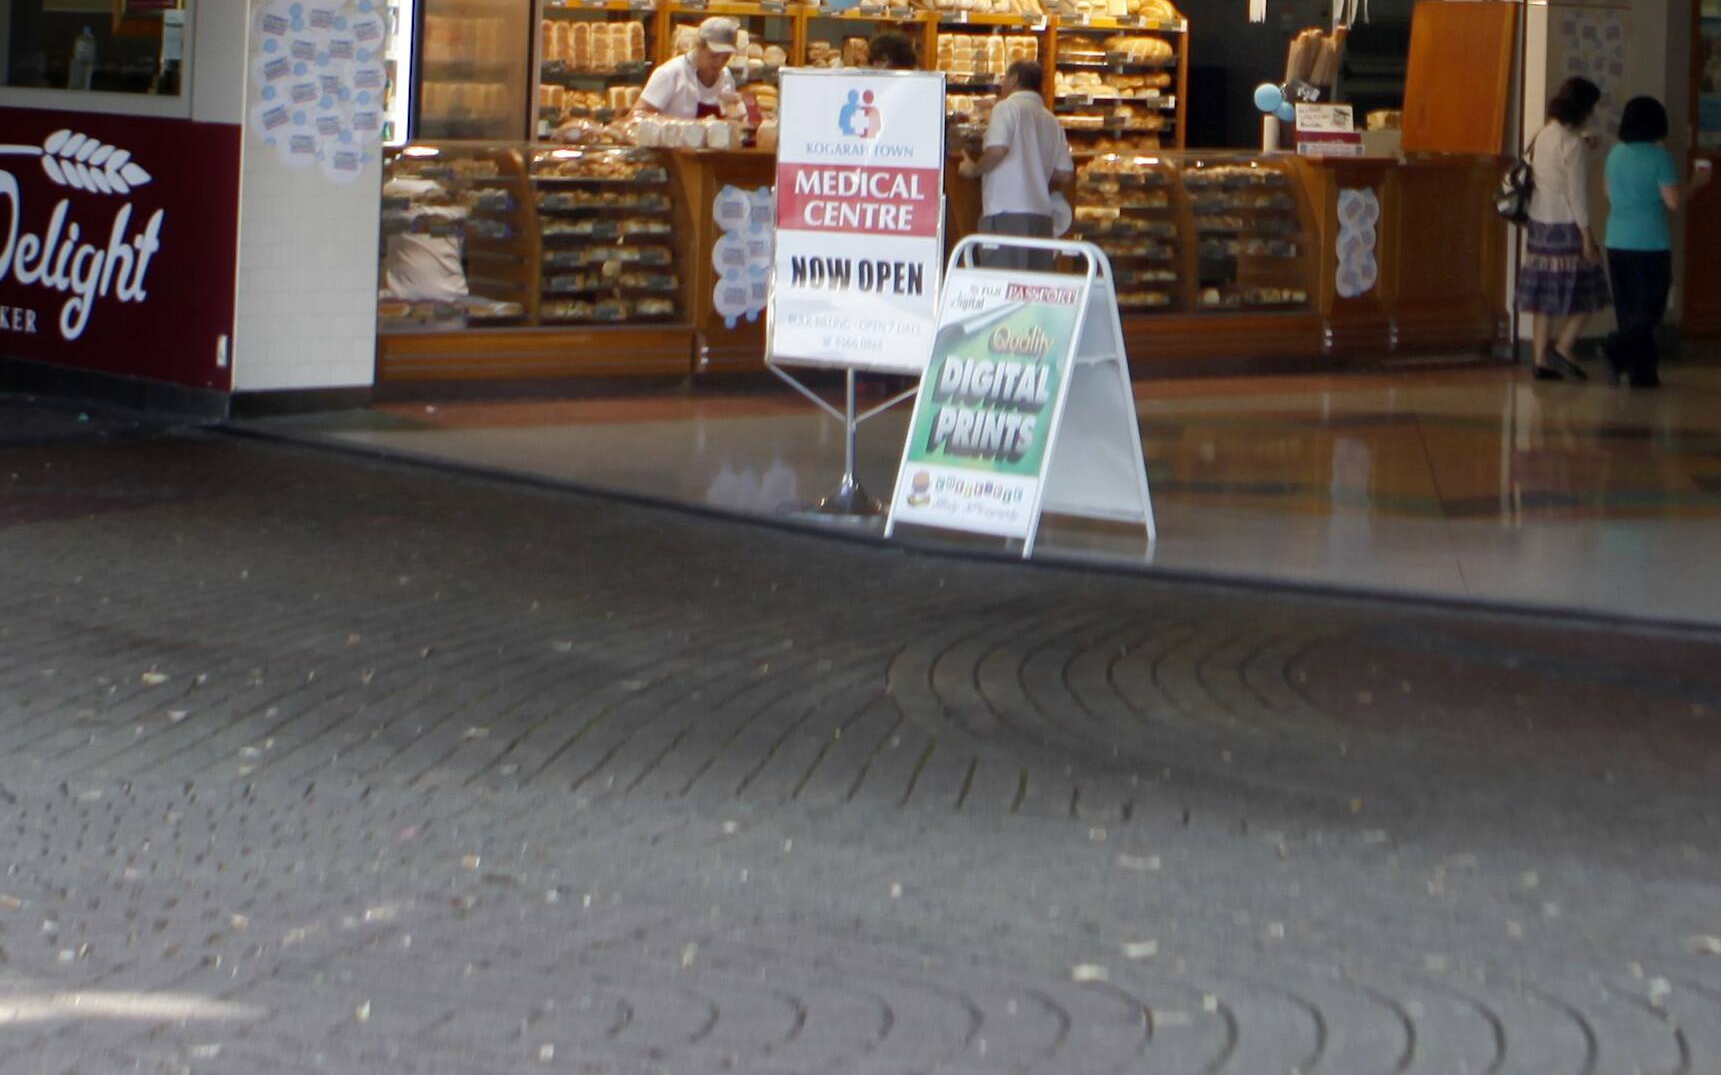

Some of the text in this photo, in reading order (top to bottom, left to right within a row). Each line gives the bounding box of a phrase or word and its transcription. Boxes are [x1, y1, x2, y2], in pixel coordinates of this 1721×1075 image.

[805, 142, 914, 158] KOGARA TOWN
[794, 169, 925, 201] MEDICAL
[803, 200, 914, 231] CENTRE
[0, 169, 164, 340] elight
[790, 254, 924, 297] NOW OPEN
[1008, 285, 1078, 304] PASSPORT
[0, 305, 37, 333] KER
[991, 325, 1054, 358] Quality
[939, 356, 1050, 406] DIGITAL
[934, 407, 1037, 454] PRINTS
